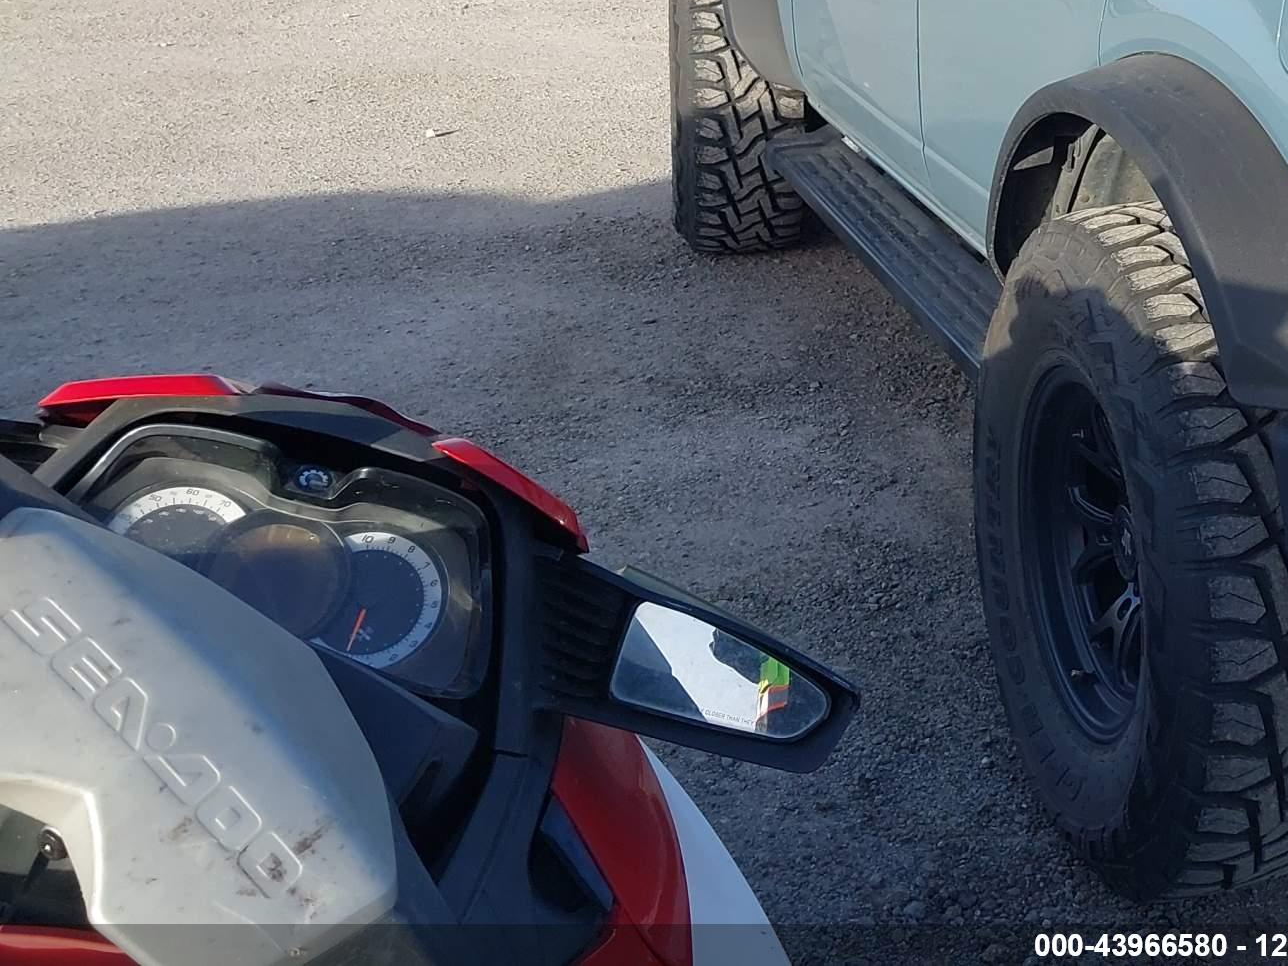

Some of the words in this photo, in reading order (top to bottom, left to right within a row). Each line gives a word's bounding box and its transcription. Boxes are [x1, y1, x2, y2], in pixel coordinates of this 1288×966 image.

[186, 488, 200, 496] 60
[219, 499, 232, 508] 70
[362, 534, 375, 544] 10
[387, 536, 397, 545] 9
[407, 545, 416, 554] 8
[423, 561, 431, 569] 7
[430, 579, 439, 588] 6
[430, 600, 438, 609] 5
[705, 709, 726, 719] CLOSER
[726, 715, 740, 723] THAN
